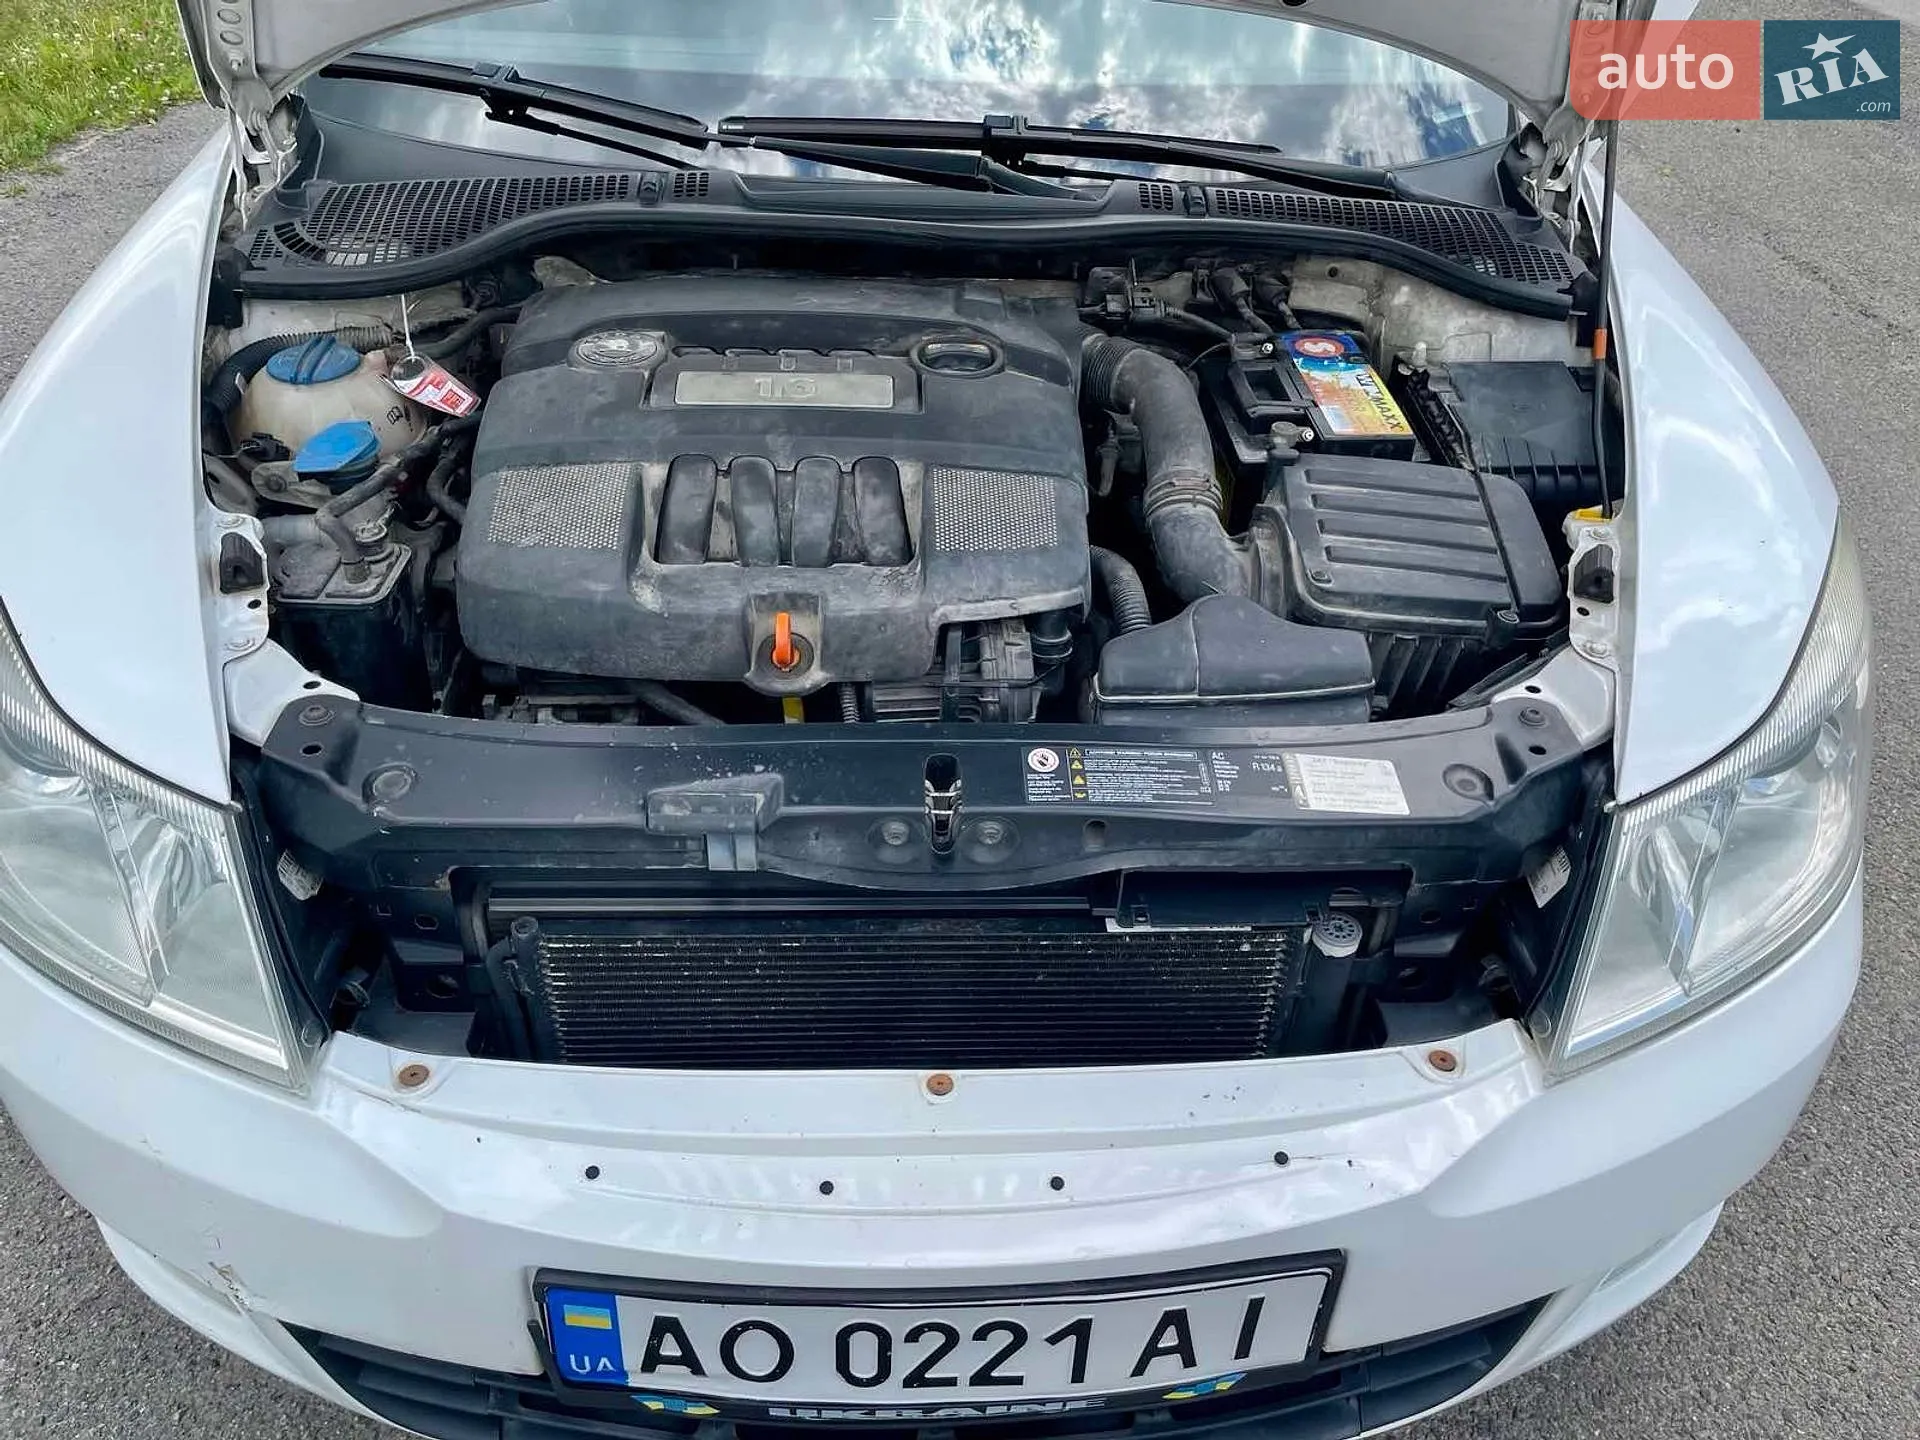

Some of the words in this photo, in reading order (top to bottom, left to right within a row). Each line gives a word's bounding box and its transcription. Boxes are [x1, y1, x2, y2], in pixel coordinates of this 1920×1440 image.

[569, 1353, 618, 1374] UA
[639, 1314, 795, 1384] AO
[834, 1316, 1095, 1389] 0221
